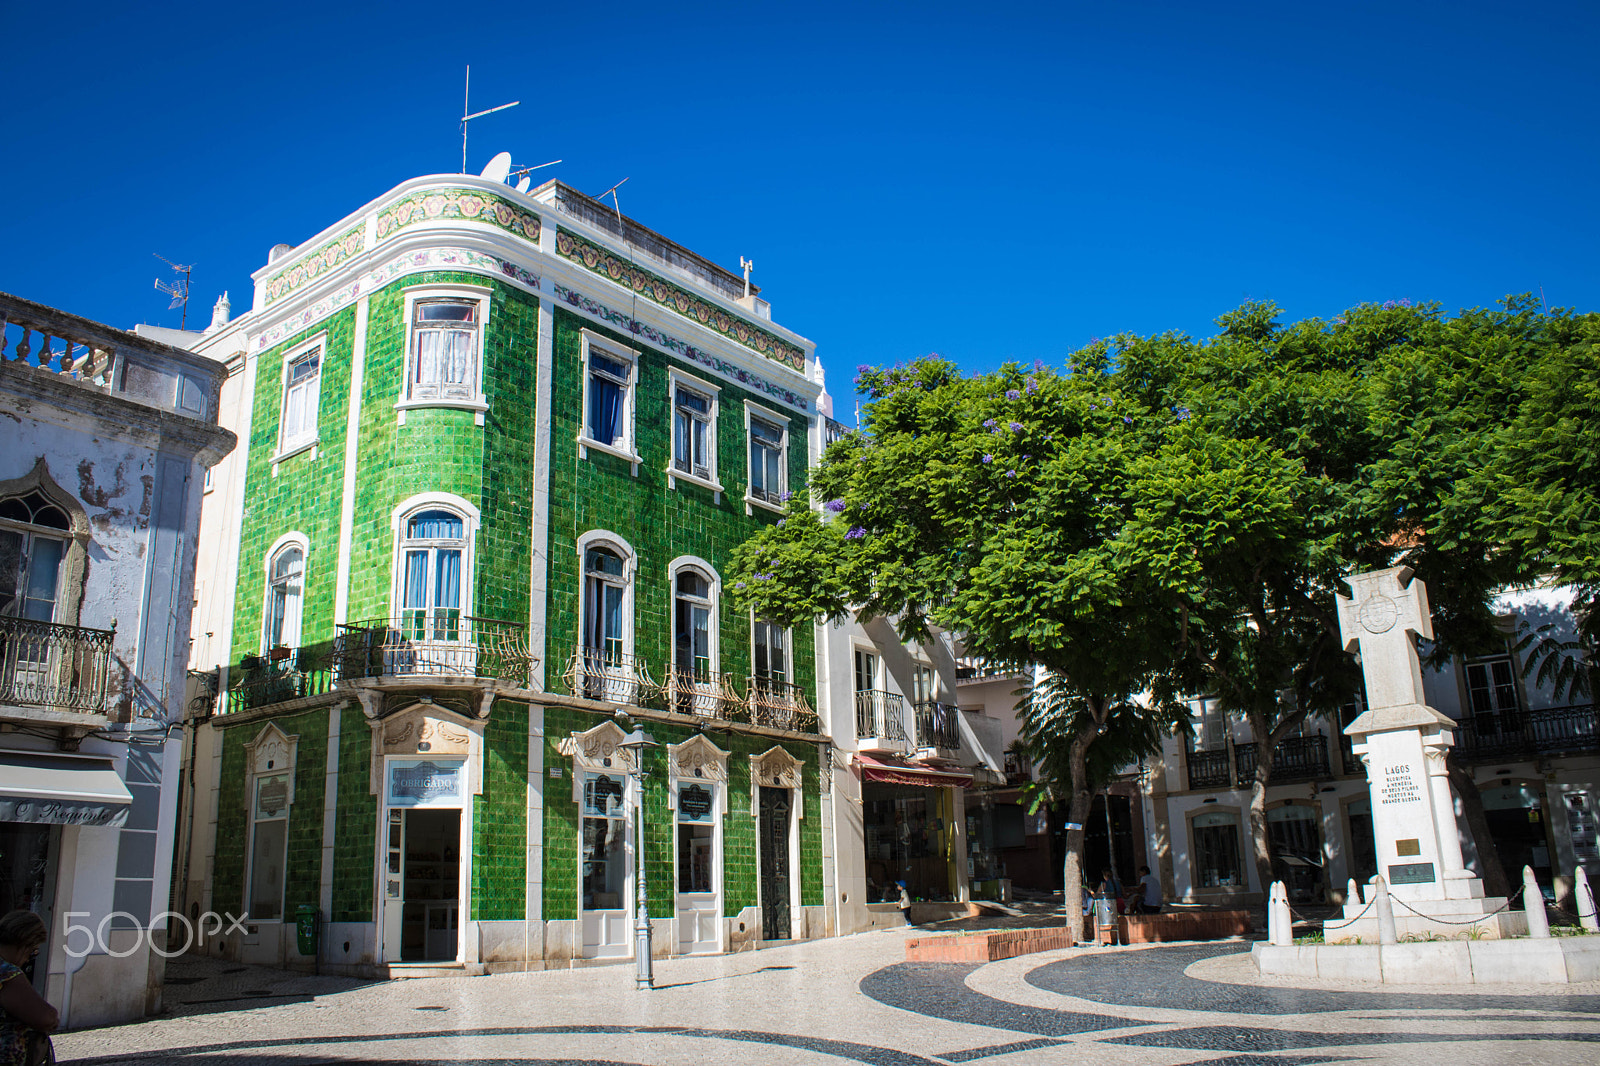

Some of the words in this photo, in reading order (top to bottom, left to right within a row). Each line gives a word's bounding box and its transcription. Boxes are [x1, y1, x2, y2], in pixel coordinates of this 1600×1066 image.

[1384, 764, 1410, 775] LAGOS
[400, 779, 452, 788] OBRIGADO
[39, 802, 109, 823] Requinte
